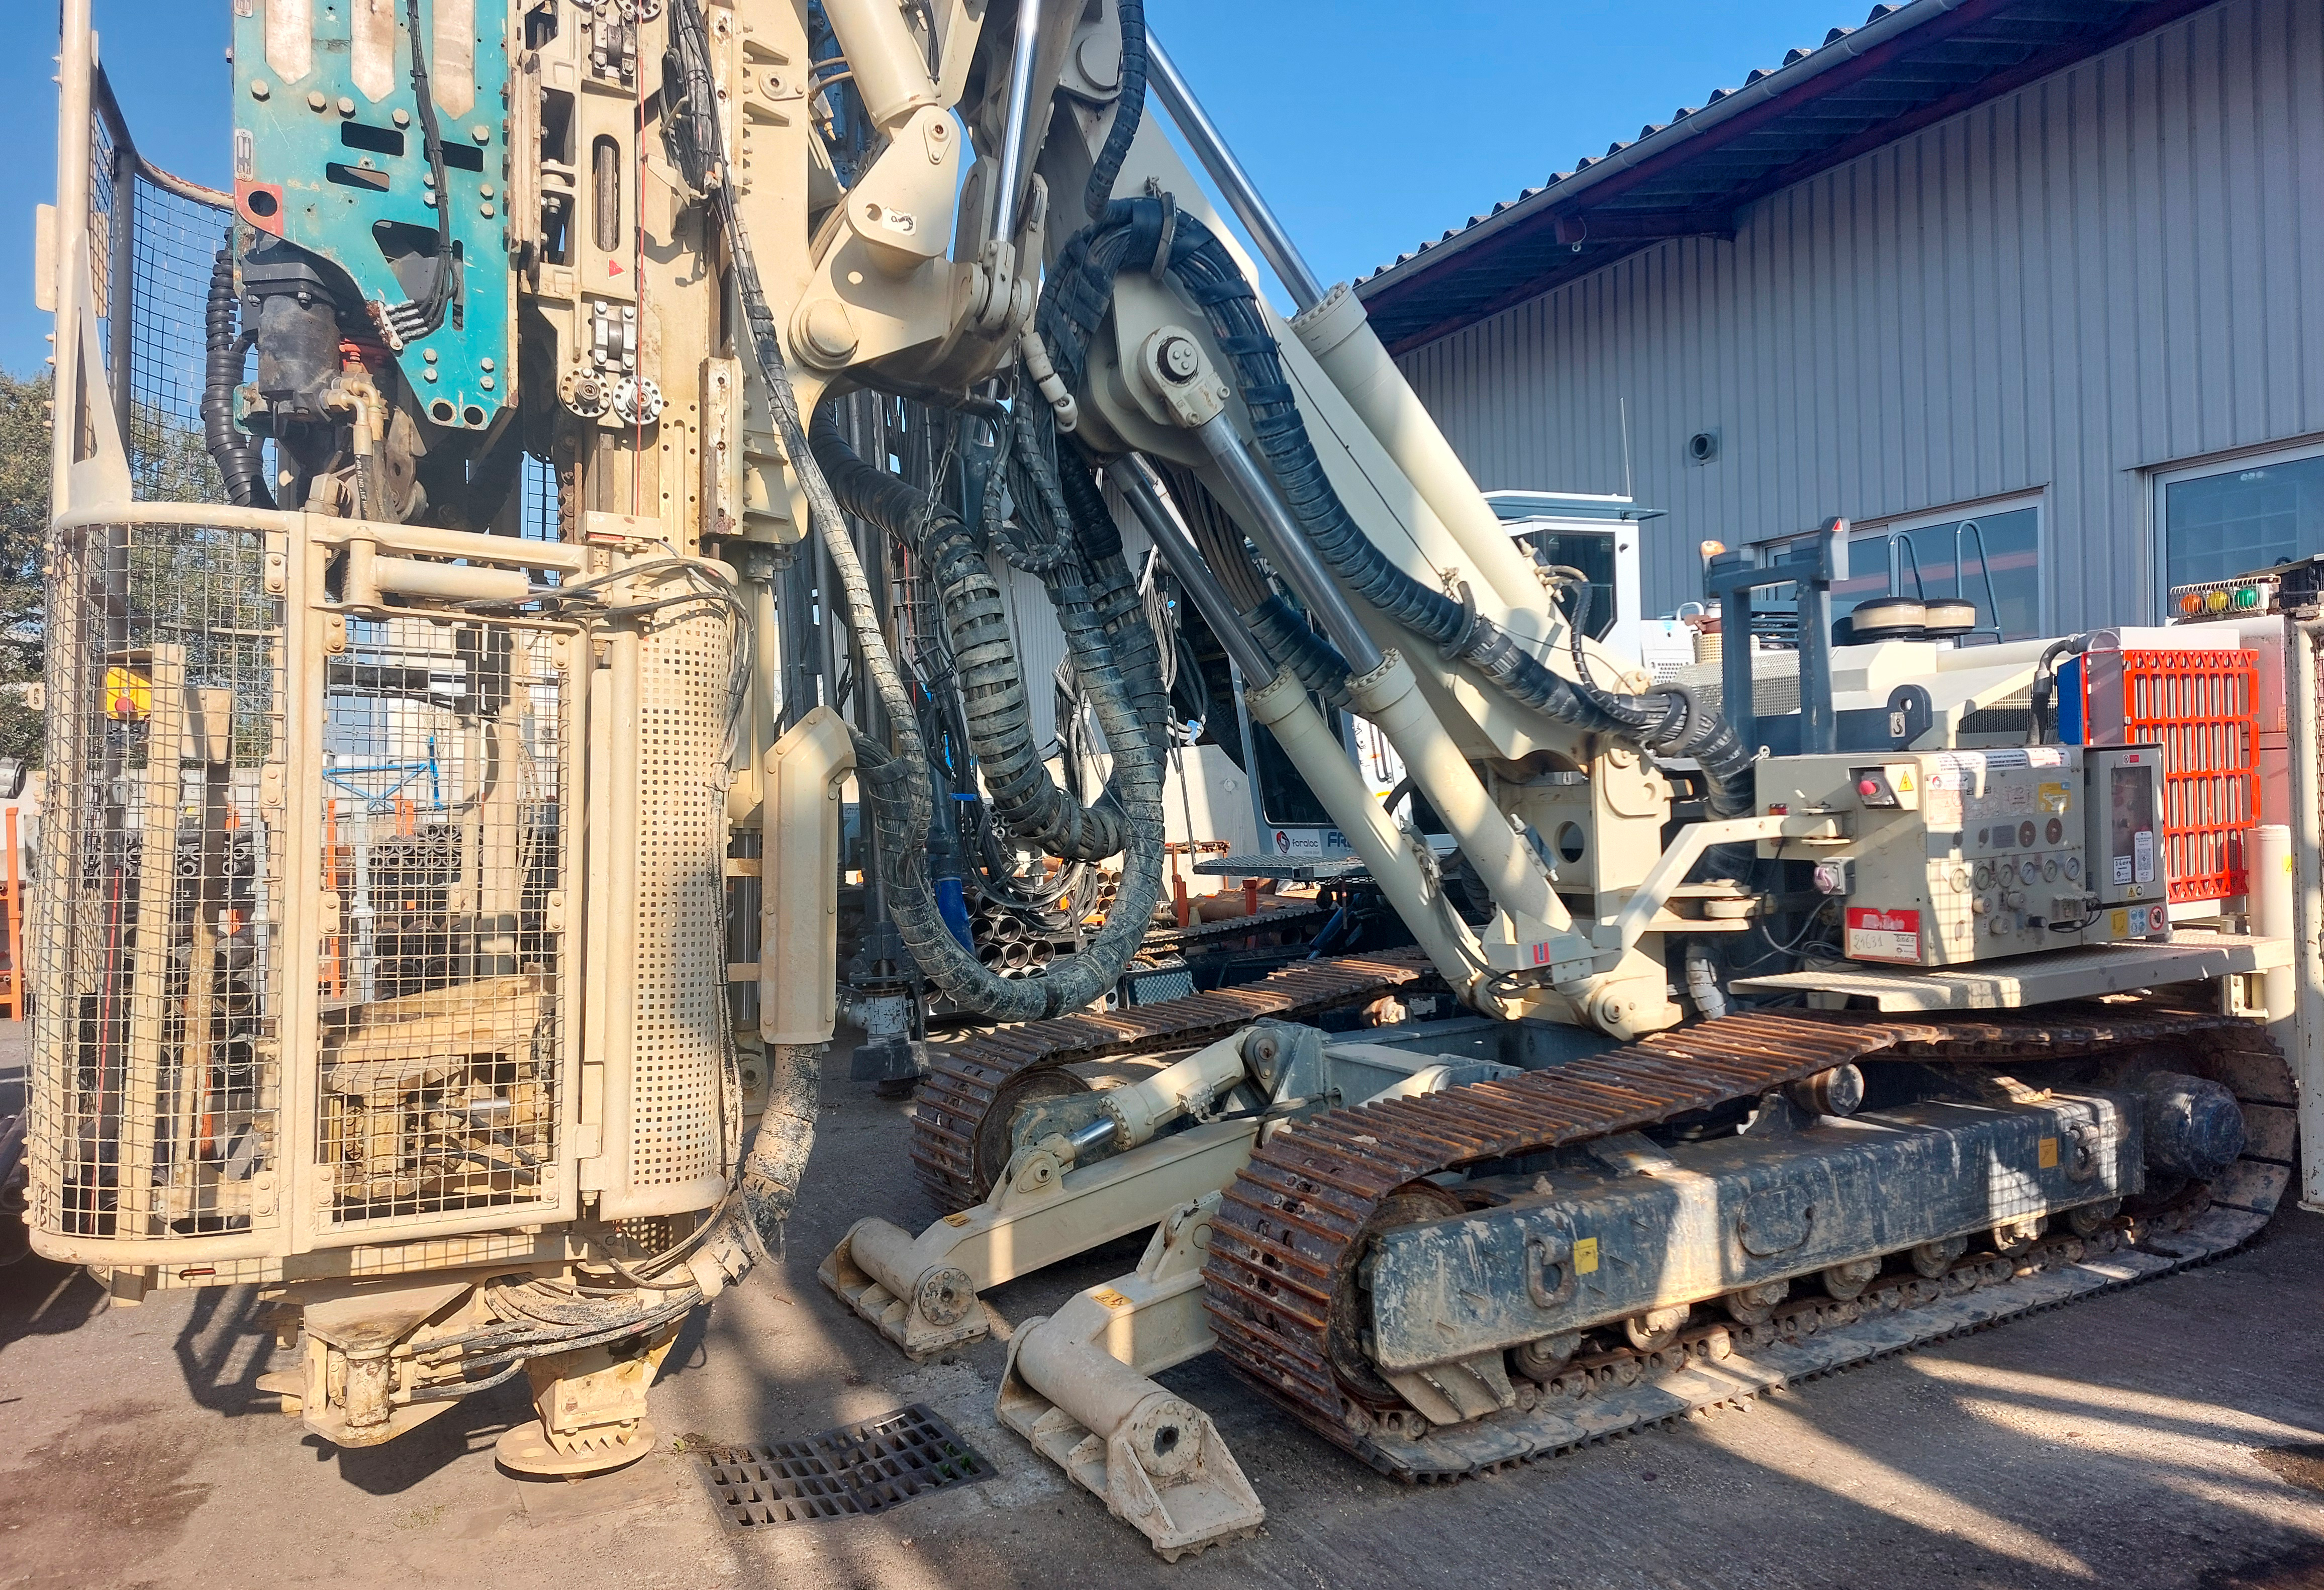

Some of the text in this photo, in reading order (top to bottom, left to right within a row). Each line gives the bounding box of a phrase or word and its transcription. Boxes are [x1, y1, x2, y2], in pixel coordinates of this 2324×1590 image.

[356, 459, 362, 470] WP
[358, 478, 364, 488] DN
[1292, 839, 1318, 848] foraloc
